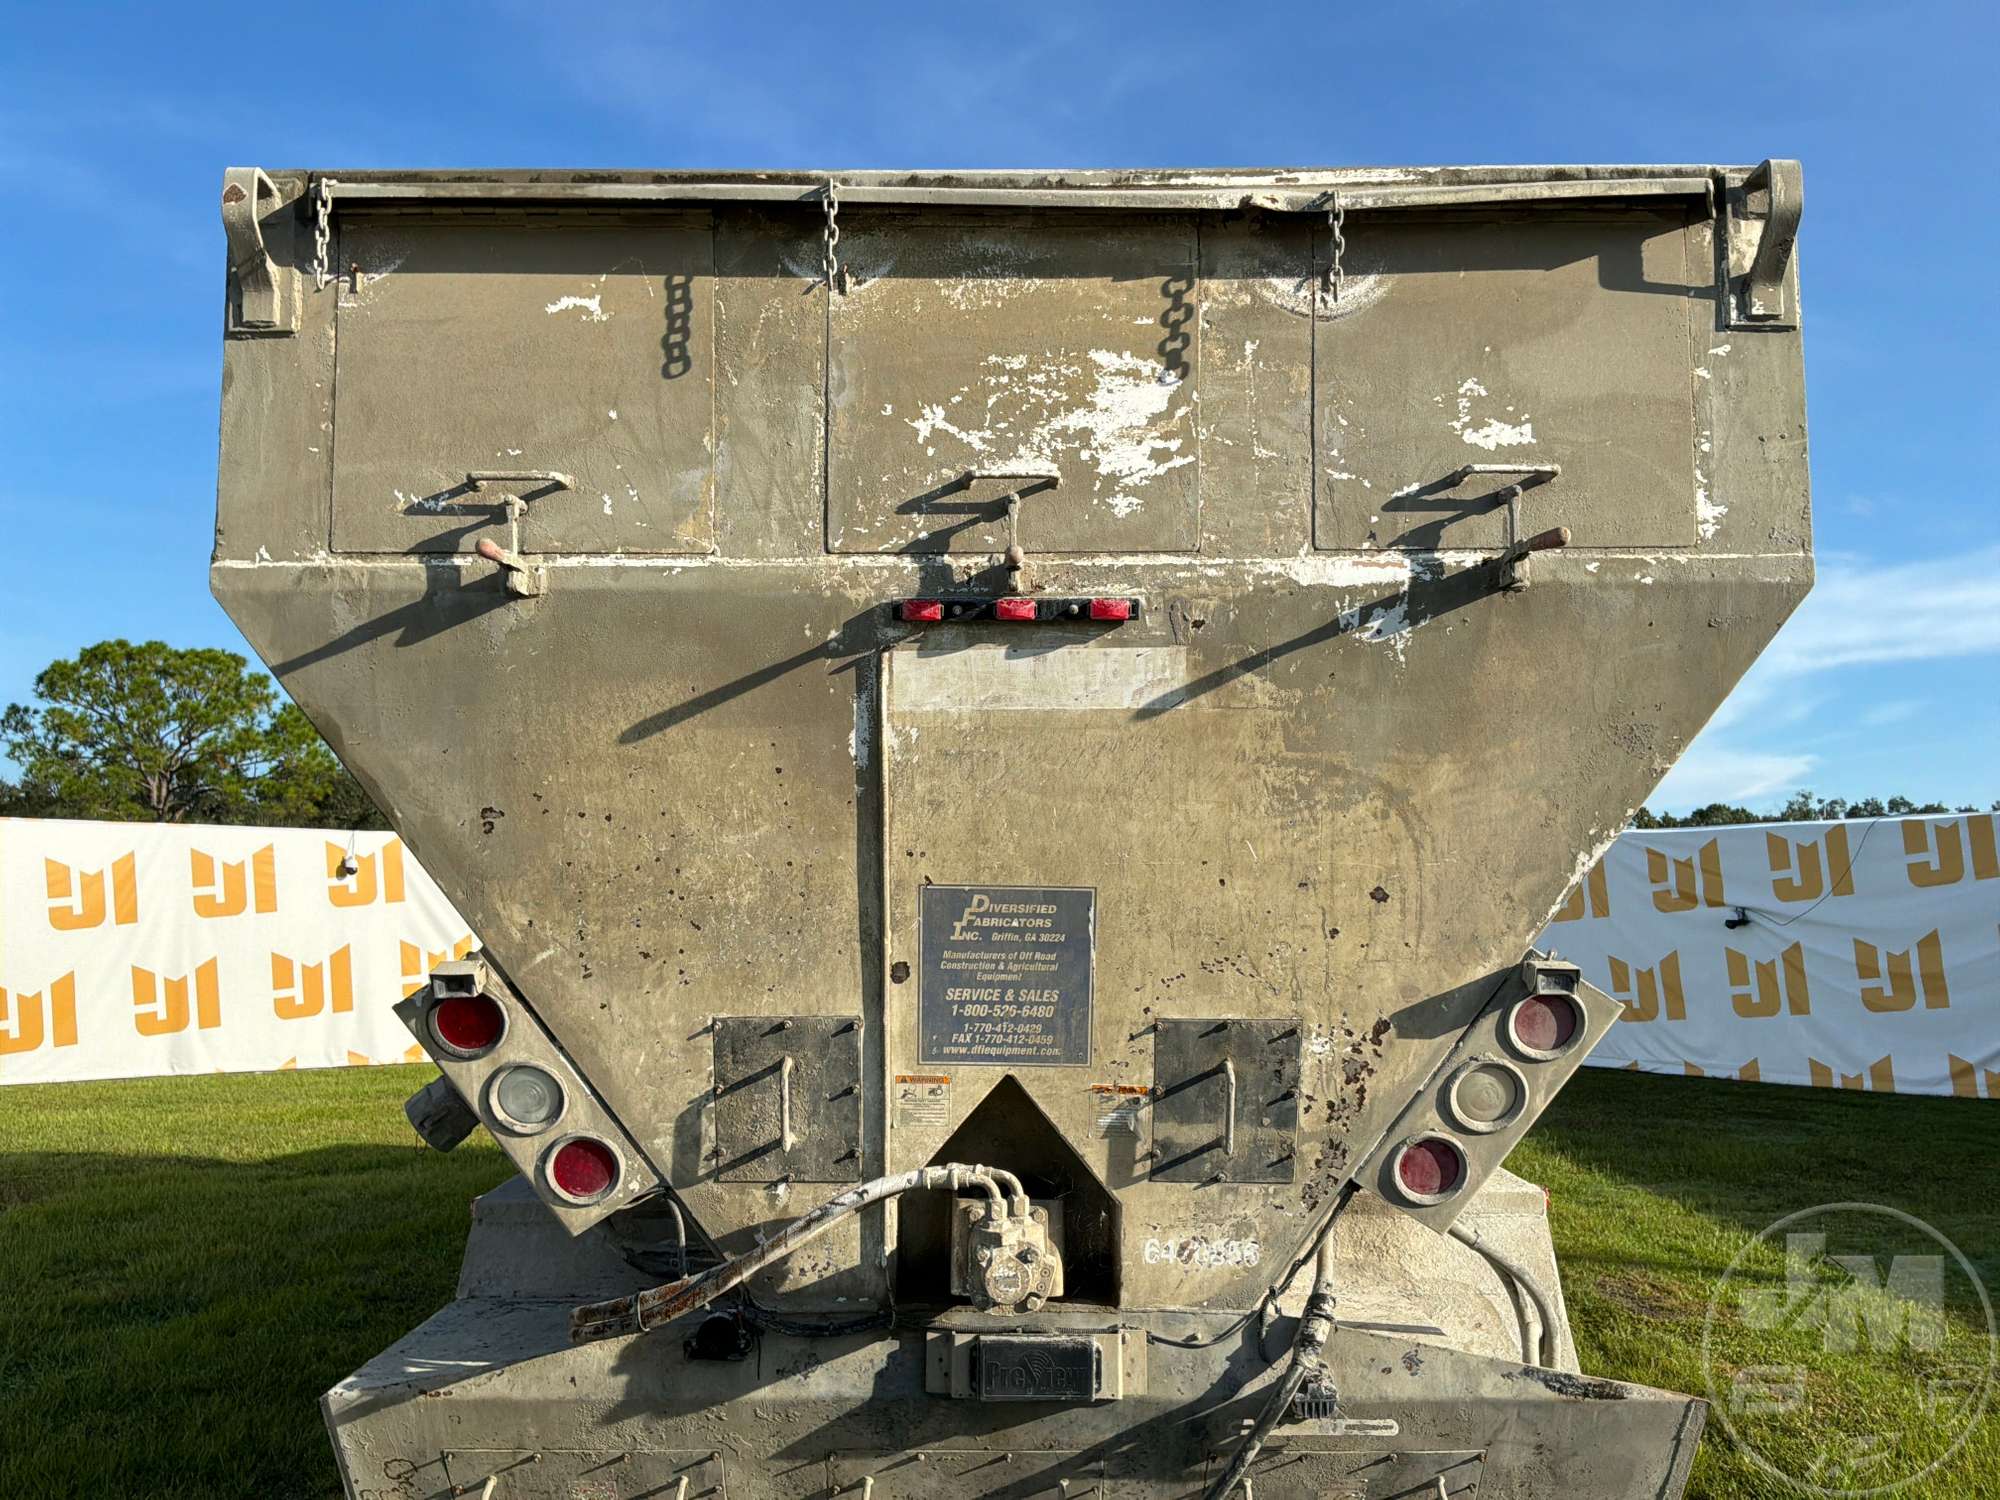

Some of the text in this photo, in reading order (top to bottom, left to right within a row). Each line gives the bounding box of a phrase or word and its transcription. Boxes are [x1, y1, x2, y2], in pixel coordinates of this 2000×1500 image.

[991, 932, 1022, 943] Griffin,
[1024, 933, 1036, 942] GA
[1038, 933, 1066, 943] 30224
[943, 950, 1057, 961] Manufacturers of Off Road
[940, 960, 1059, 973] Construction & Agricultural
[976, 972, 1023, 982] Equipment
[945, 988, 1059, 1002] SERVICE & SALES
[951, 1033, 972, 1043] FAX
